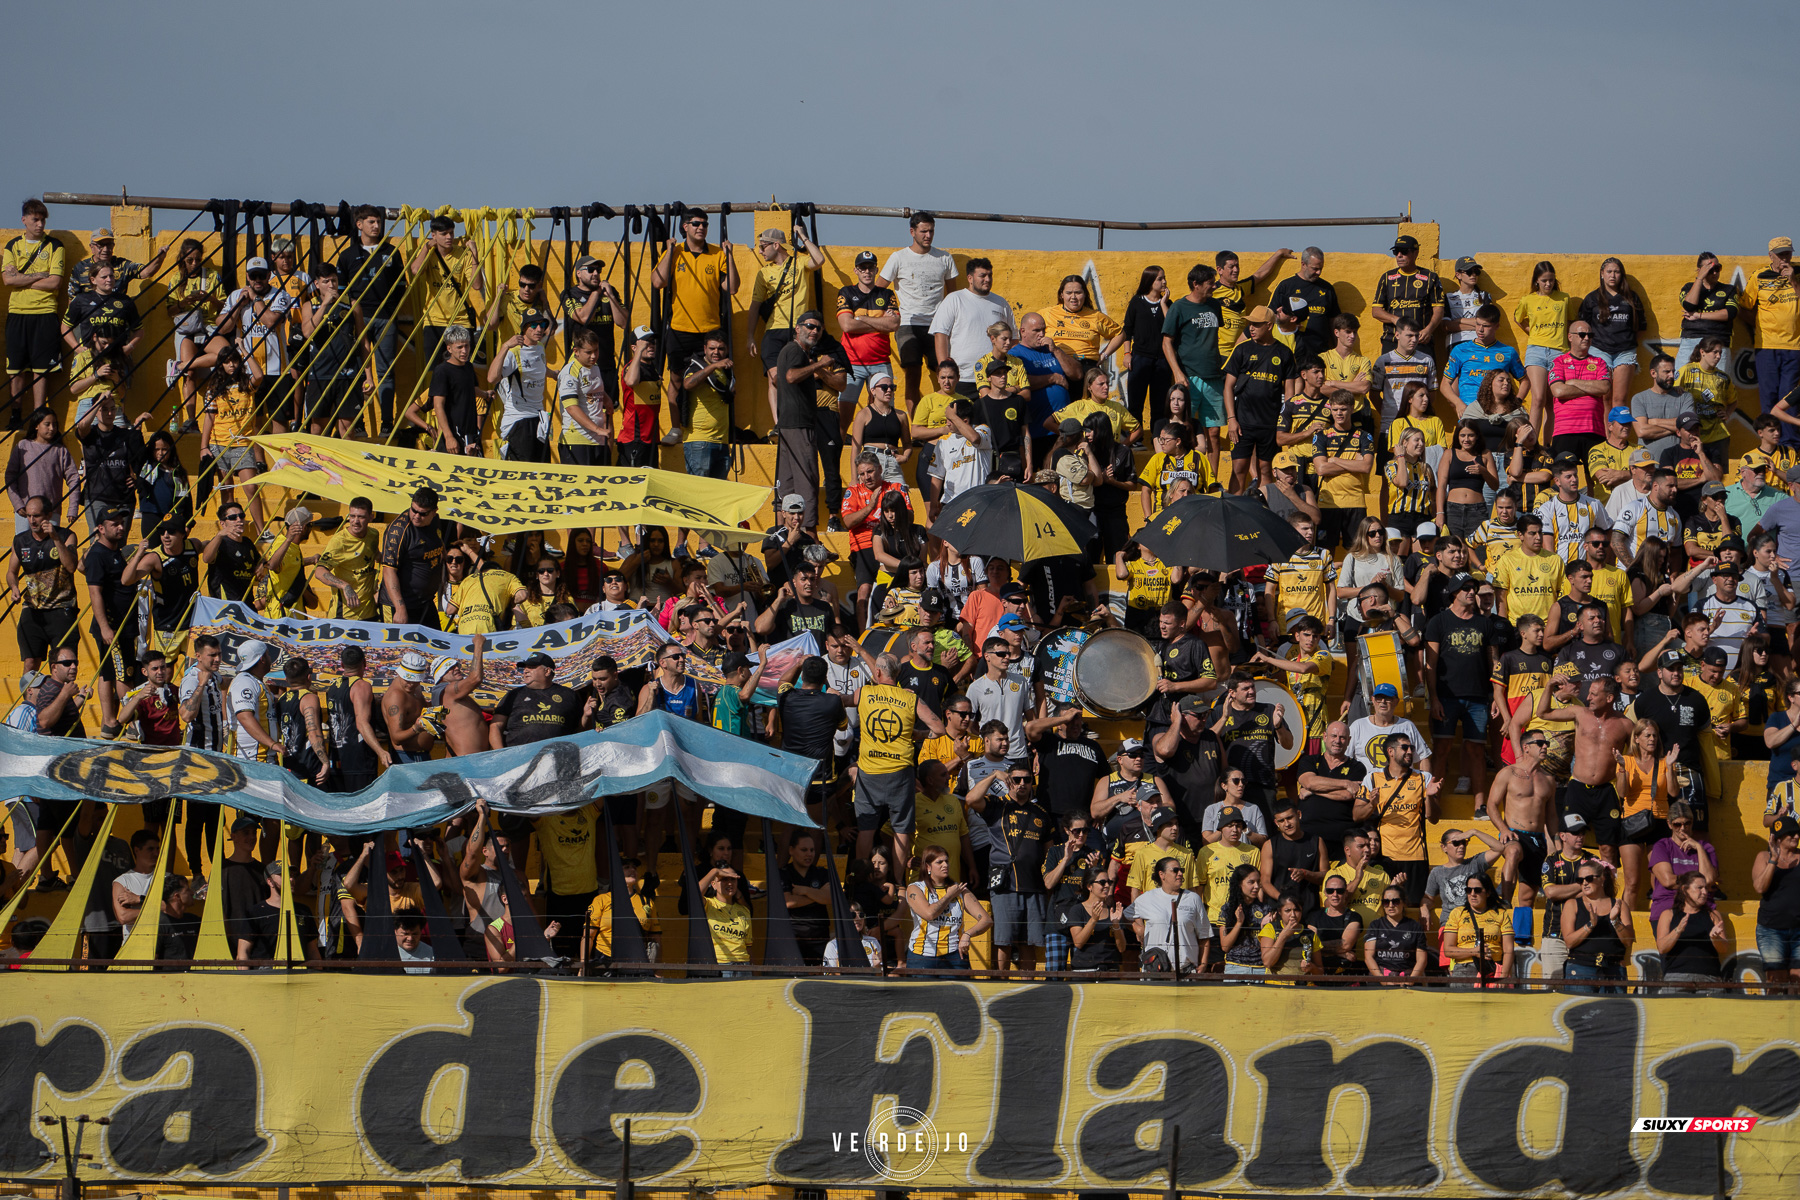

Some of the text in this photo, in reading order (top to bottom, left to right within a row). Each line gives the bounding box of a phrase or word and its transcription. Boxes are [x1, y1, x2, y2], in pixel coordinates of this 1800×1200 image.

[364, 452, 648, 485] NI LA MUERTE NOS
[446, 507, 553, 526] MONO
[1035, 521, 1056, 539] 14
[1558, 534, 1585, 543] CANAR
[1285, 585, 1320, 594] CANARIO
[1513, 586, 1554, 595] CANARIO
[211, 603, 371, 642] Arriba
[382, 627, 452, 650] los
[1583, 673, 1614, 682] ANARIO
[867, 694, 907, 708] Flandria
[522, 714, 566, 723] CANARIO
[1204, 750, 1217, 761] 14
[1388, 803, 1418, 811] ANARIO
[927, 824, 958, 834] CANARIO
[933, 915, 963, 924] ANARIO
[1460, 934, 1498, 942] CANRIO
[356, 978, 705, 1180] de
[772, 980, 1800, 1192] Flandr
